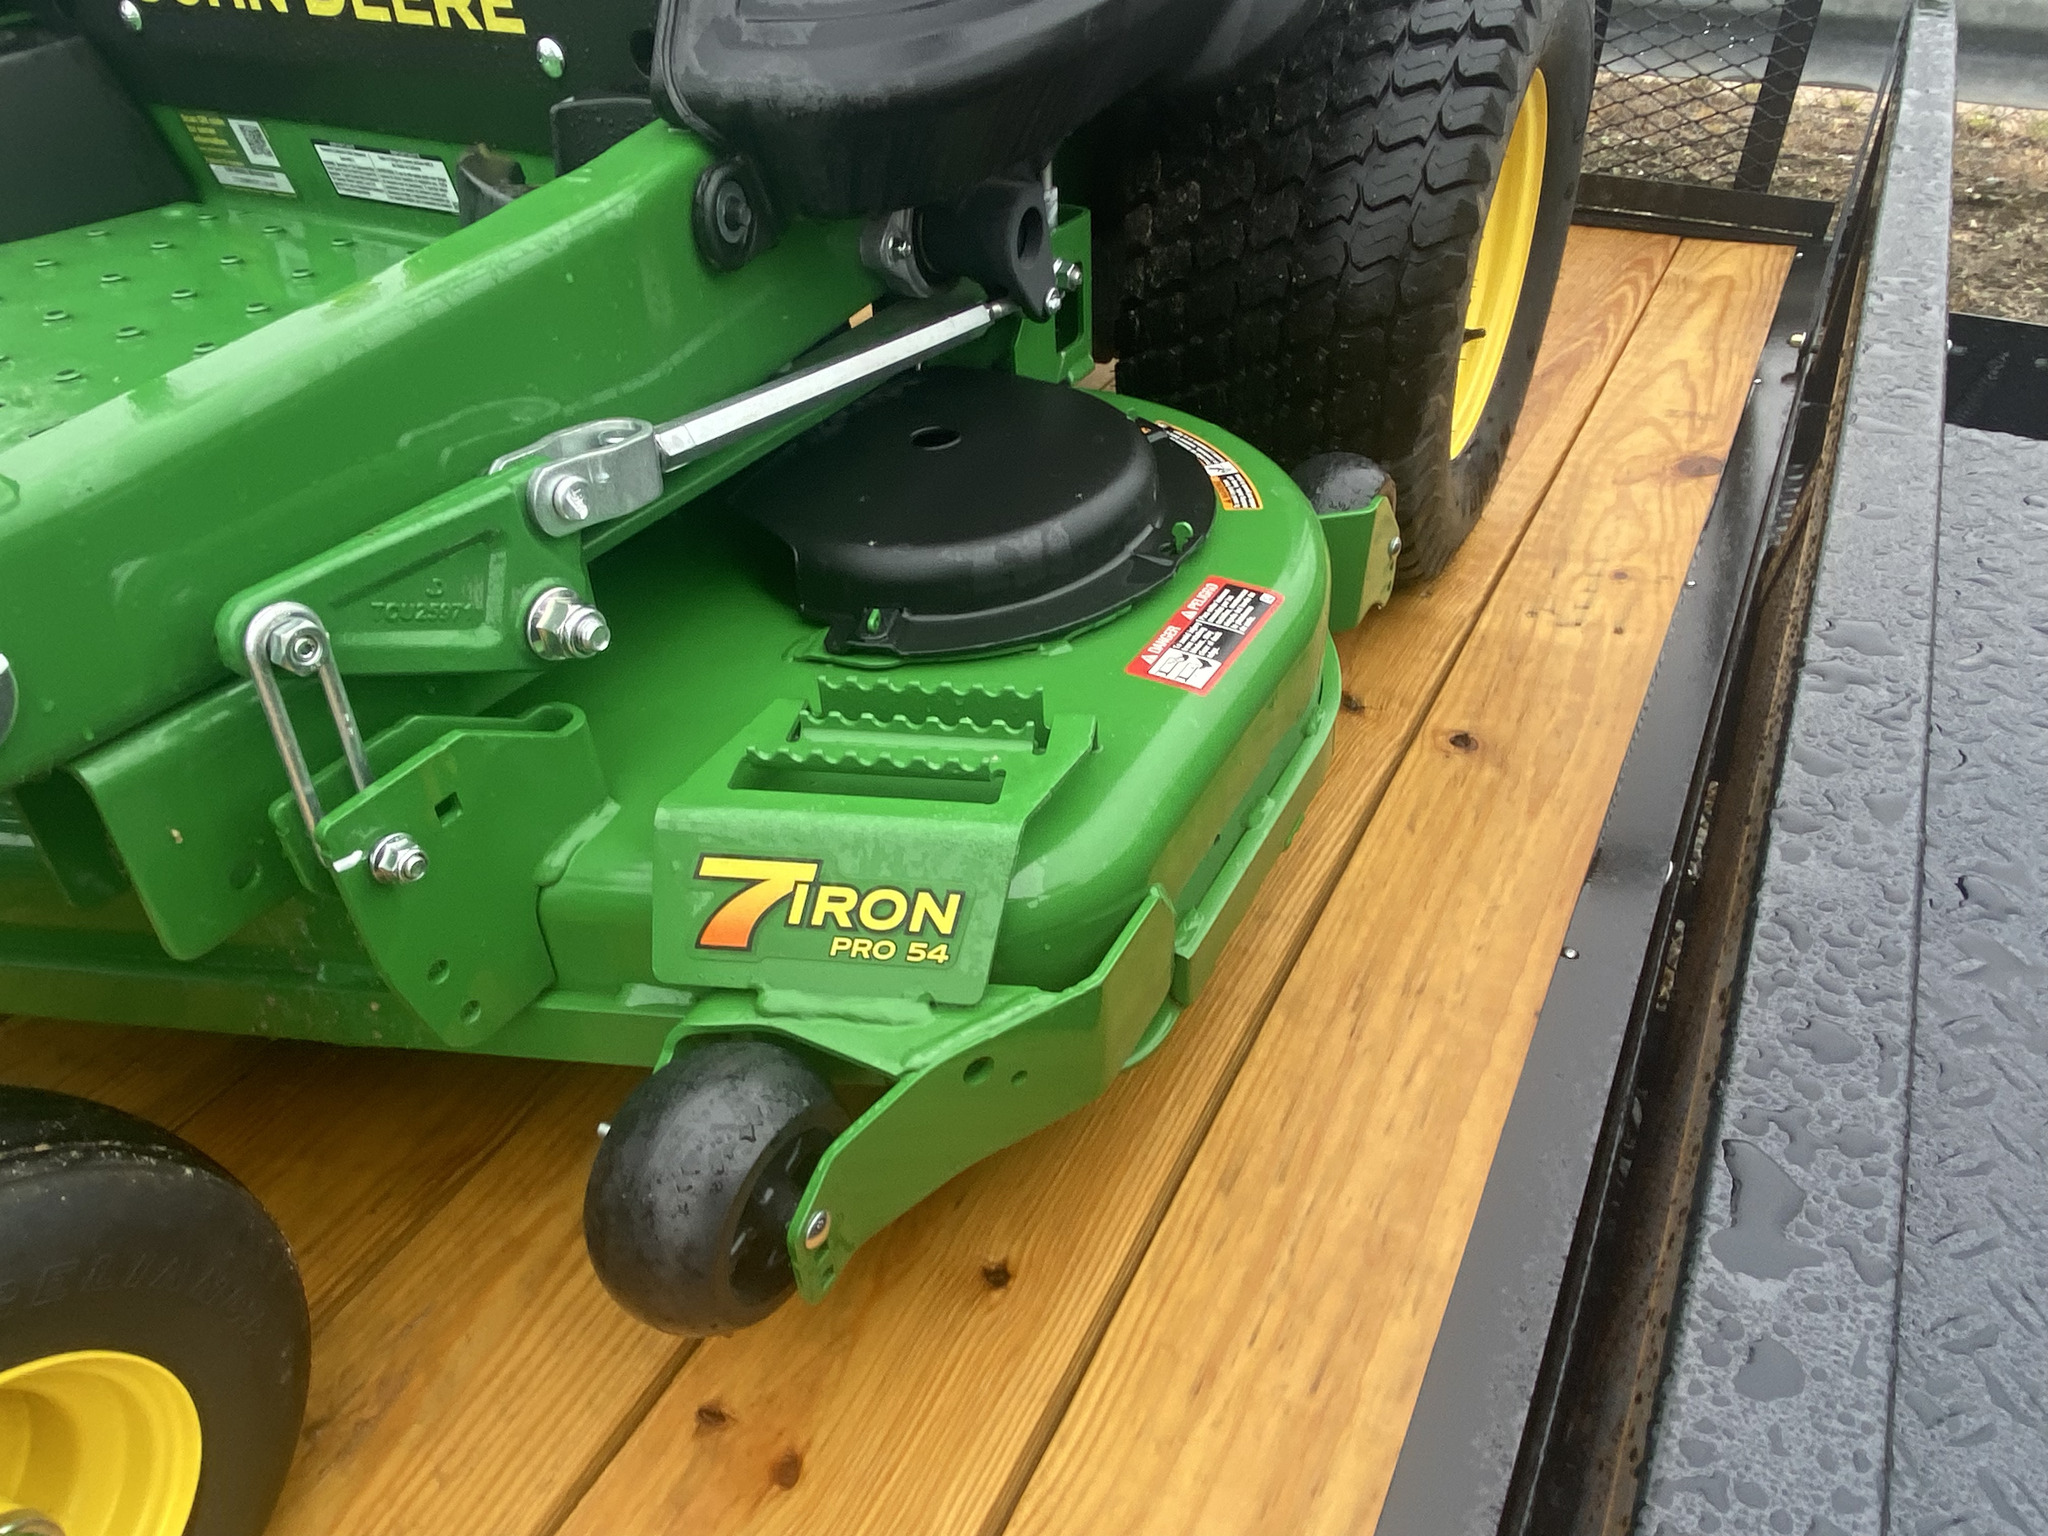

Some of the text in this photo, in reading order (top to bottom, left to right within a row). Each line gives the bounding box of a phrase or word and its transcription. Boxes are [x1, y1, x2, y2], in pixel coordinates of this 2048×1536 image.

[1187, 583, 1219, 611] PELIGRO
[1147, 624, 1182, 654] DANGER
[829, 936, 950, 964] PRO 54
